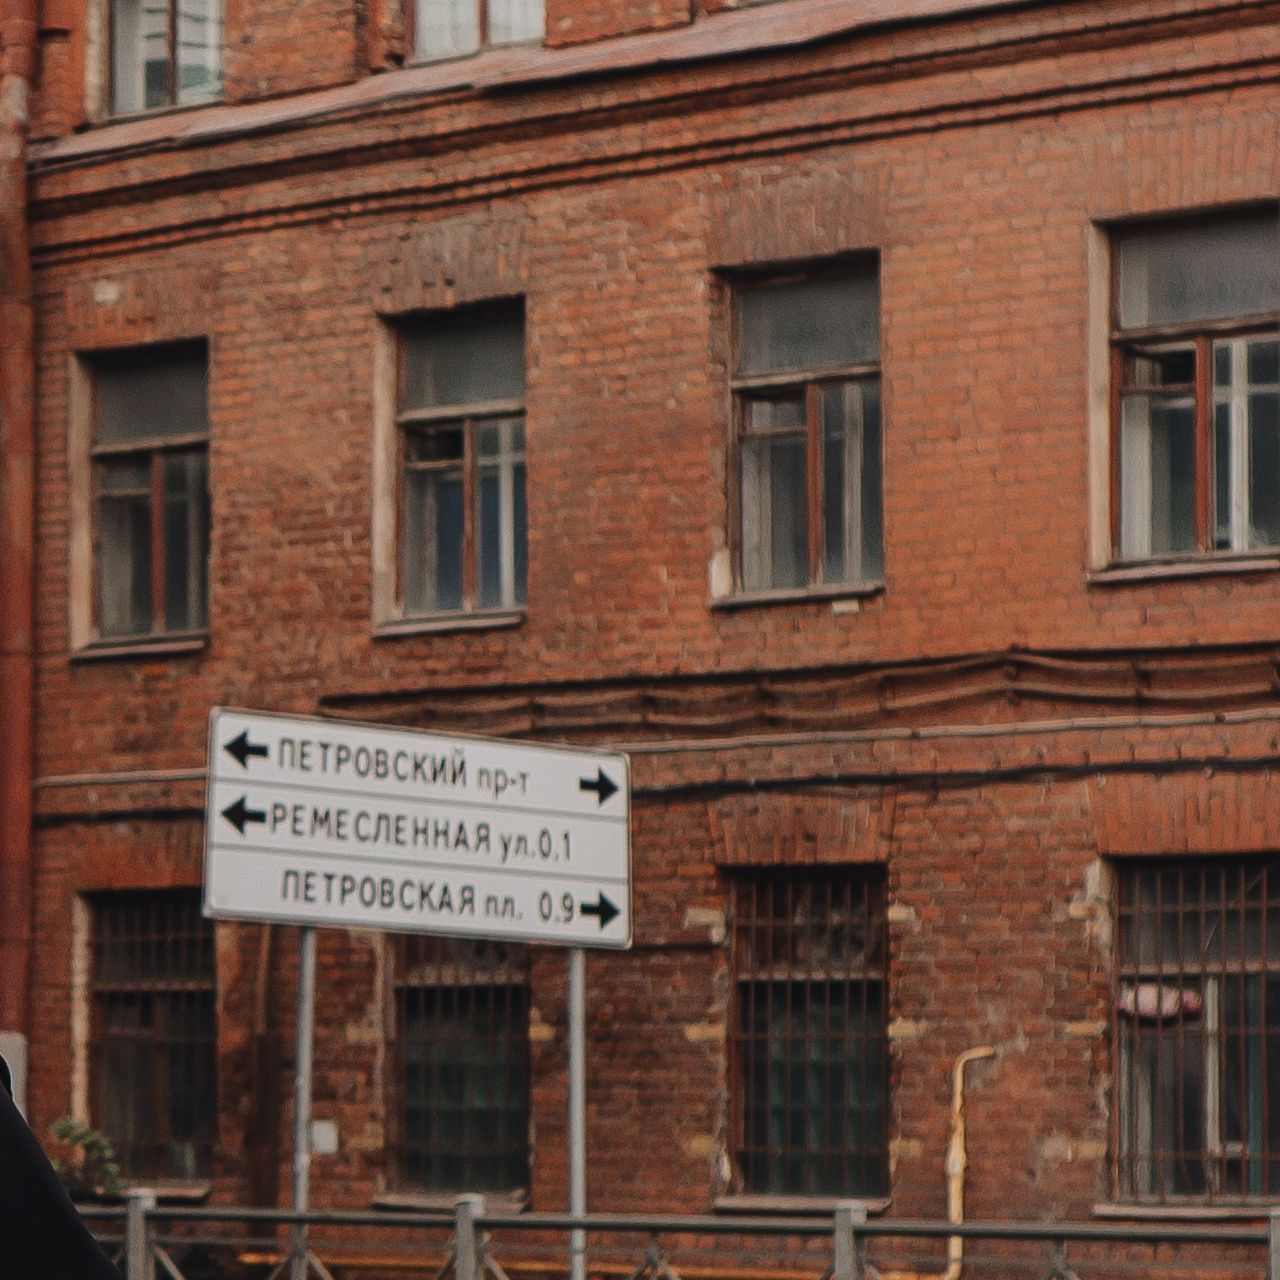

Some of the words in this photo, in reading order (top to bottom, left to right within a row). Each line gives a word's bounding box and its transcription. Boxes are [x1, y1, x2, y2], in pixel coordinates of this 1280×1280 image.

[279, 736, 467, 788] ПЕТРОВСКИЙ
[477, 767, 530, 800] пр-т
[272, 802, 490, 853] РЕМЕСЛЕННАЯ
[282, 869, 475, 916] ПЕТРОВСКАЯ
[485, 894, 523, 920] пл.
